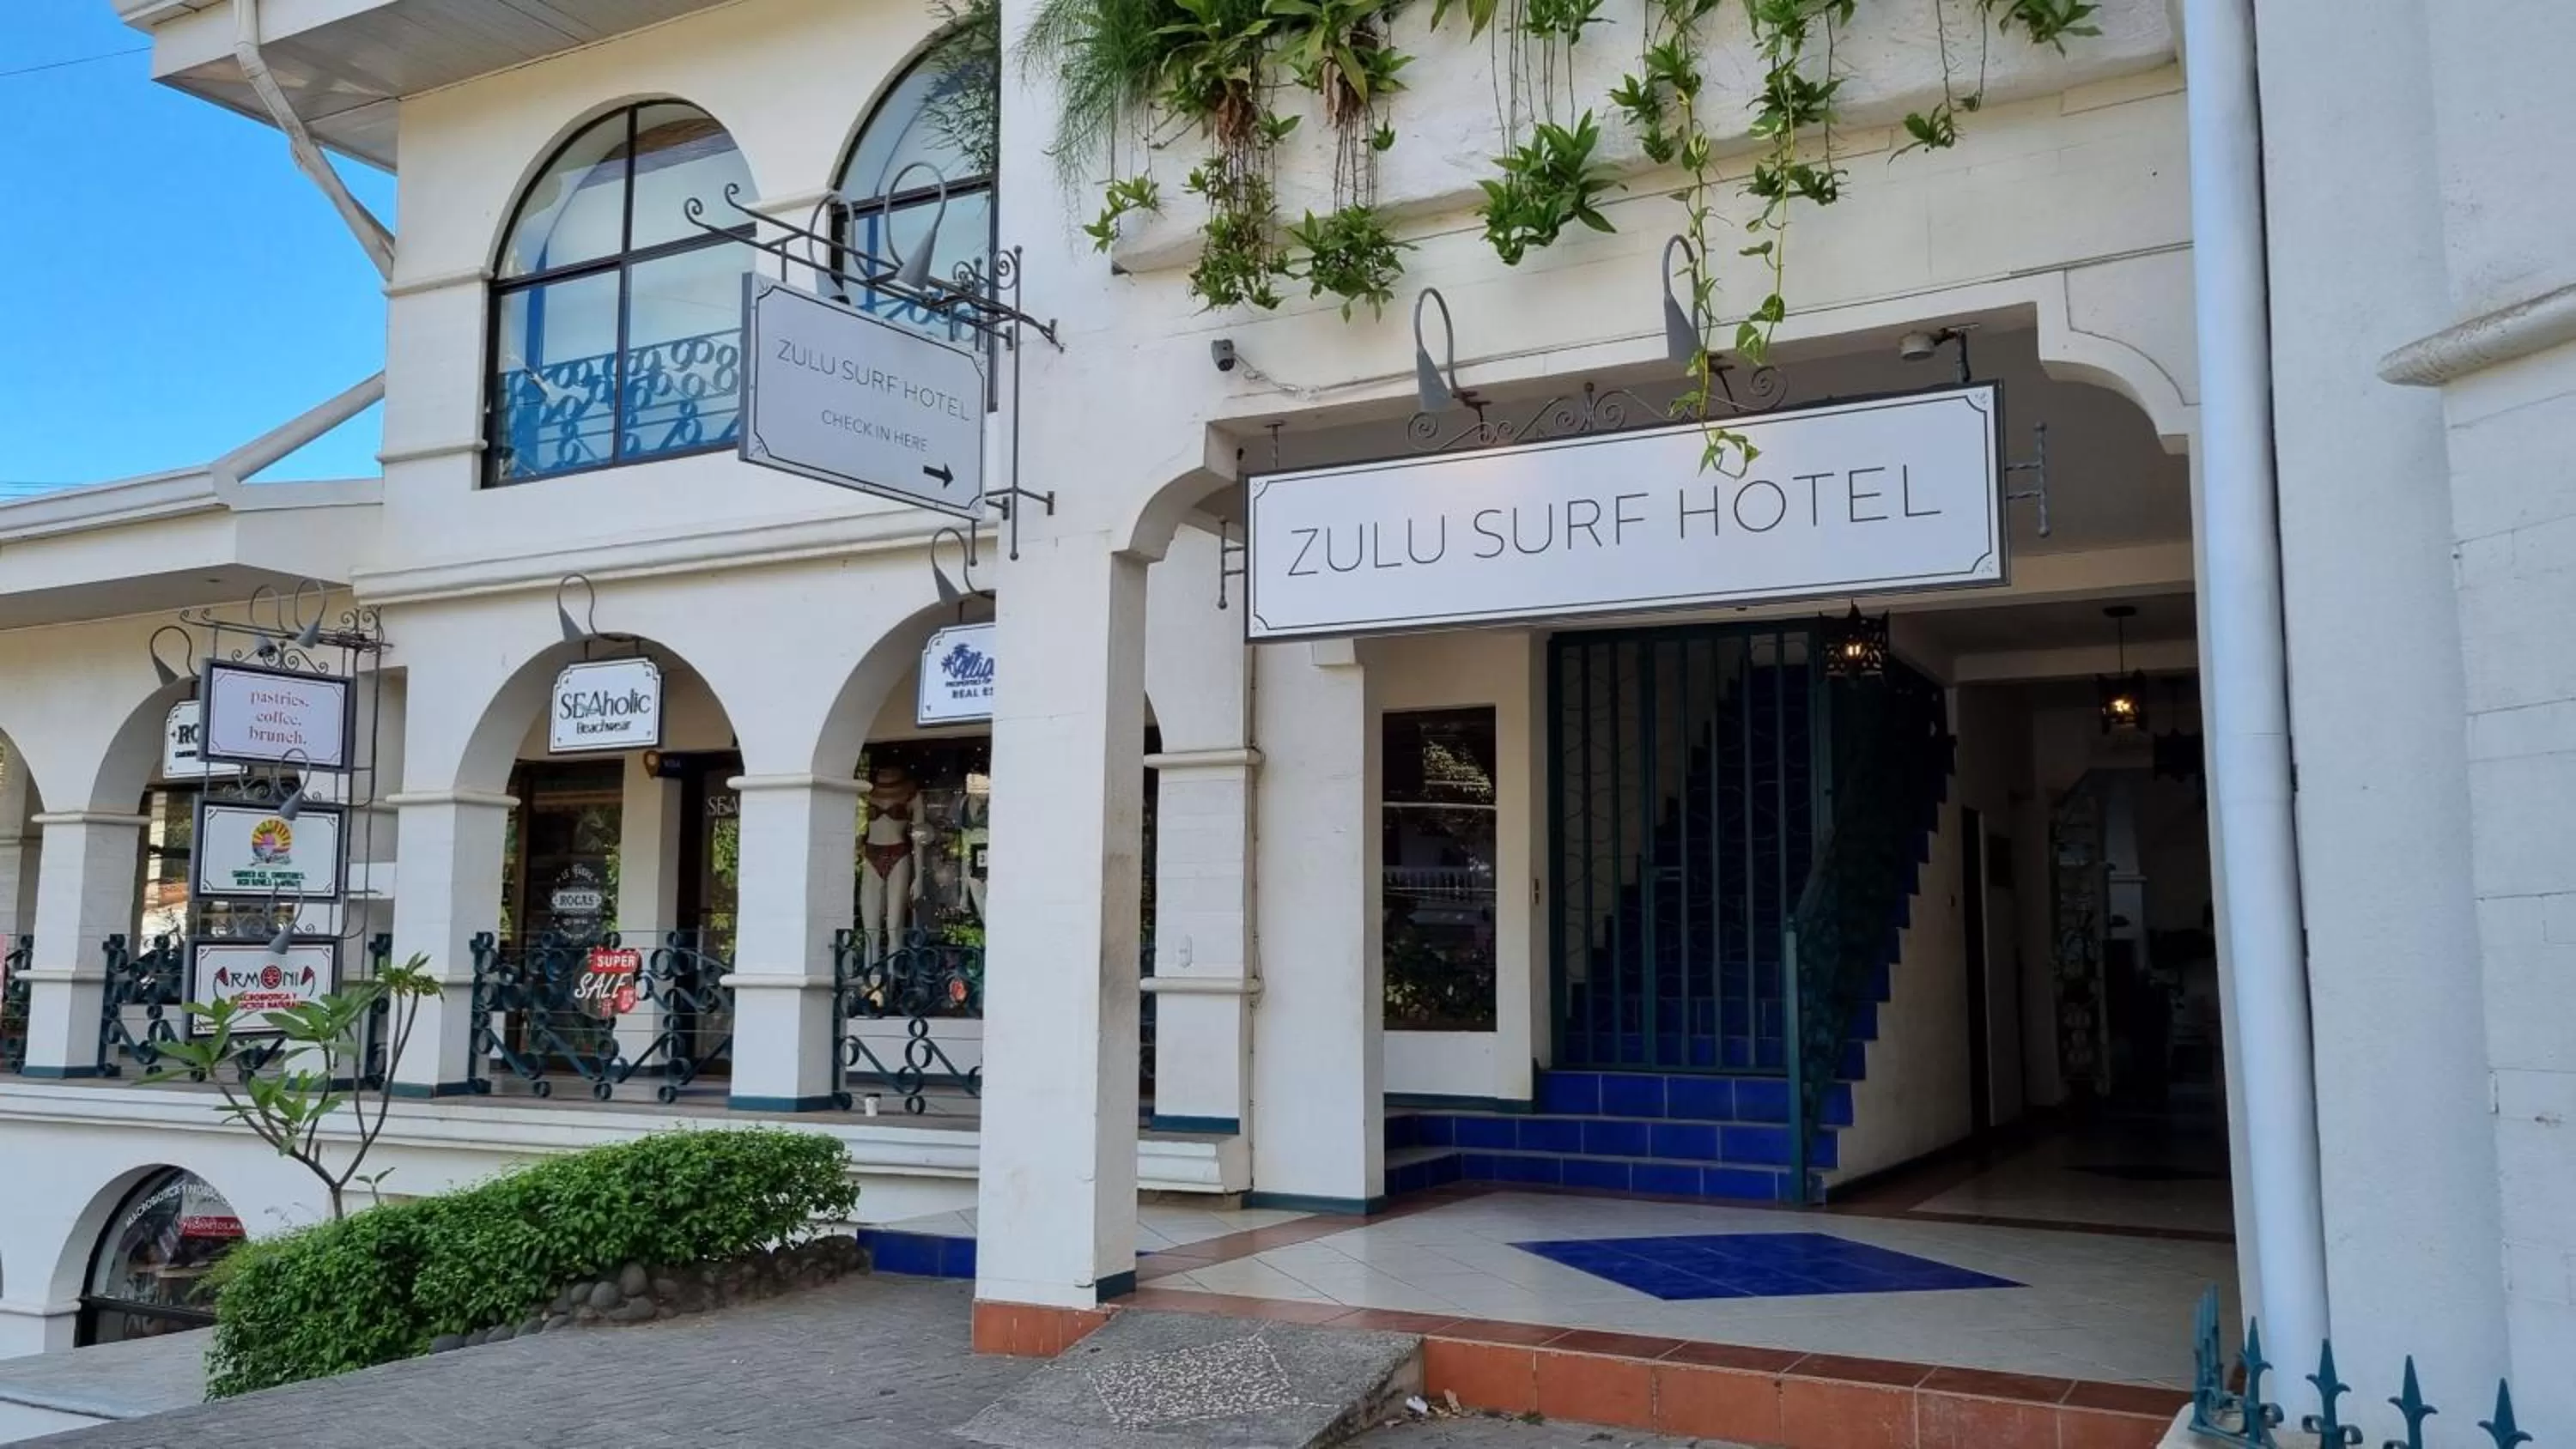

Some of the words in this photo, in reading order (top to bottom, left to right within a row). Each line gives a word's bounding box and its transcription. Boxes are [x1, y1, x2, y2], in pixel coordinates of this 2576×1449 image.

[777, 339, 836, 375] ZULU
[842, 360, 898, 393] SURF
[904, 380, 970, 421] HOTEL
[821, 409, 872, 434] CHECK
[875, 422, 890, 440] IN
[894, 431, 928, 452] HERE
[1286, 514, 1447, 577] ZULU
[1473, 492, 1649, 559] SURF
[1679, 464, 1942, 540] HOTEL
[250, 691, 310, 708] pastries.
[559, 688, 651, 719] SEAholic
[951, 688, 979, 699] REAL
[248, 724, 307, 745] brunch.
[576, 719, 632, 734] Beachwear
[596, 955, 635, 967] SUPER
[574, 971, 633, 1000] SALE
